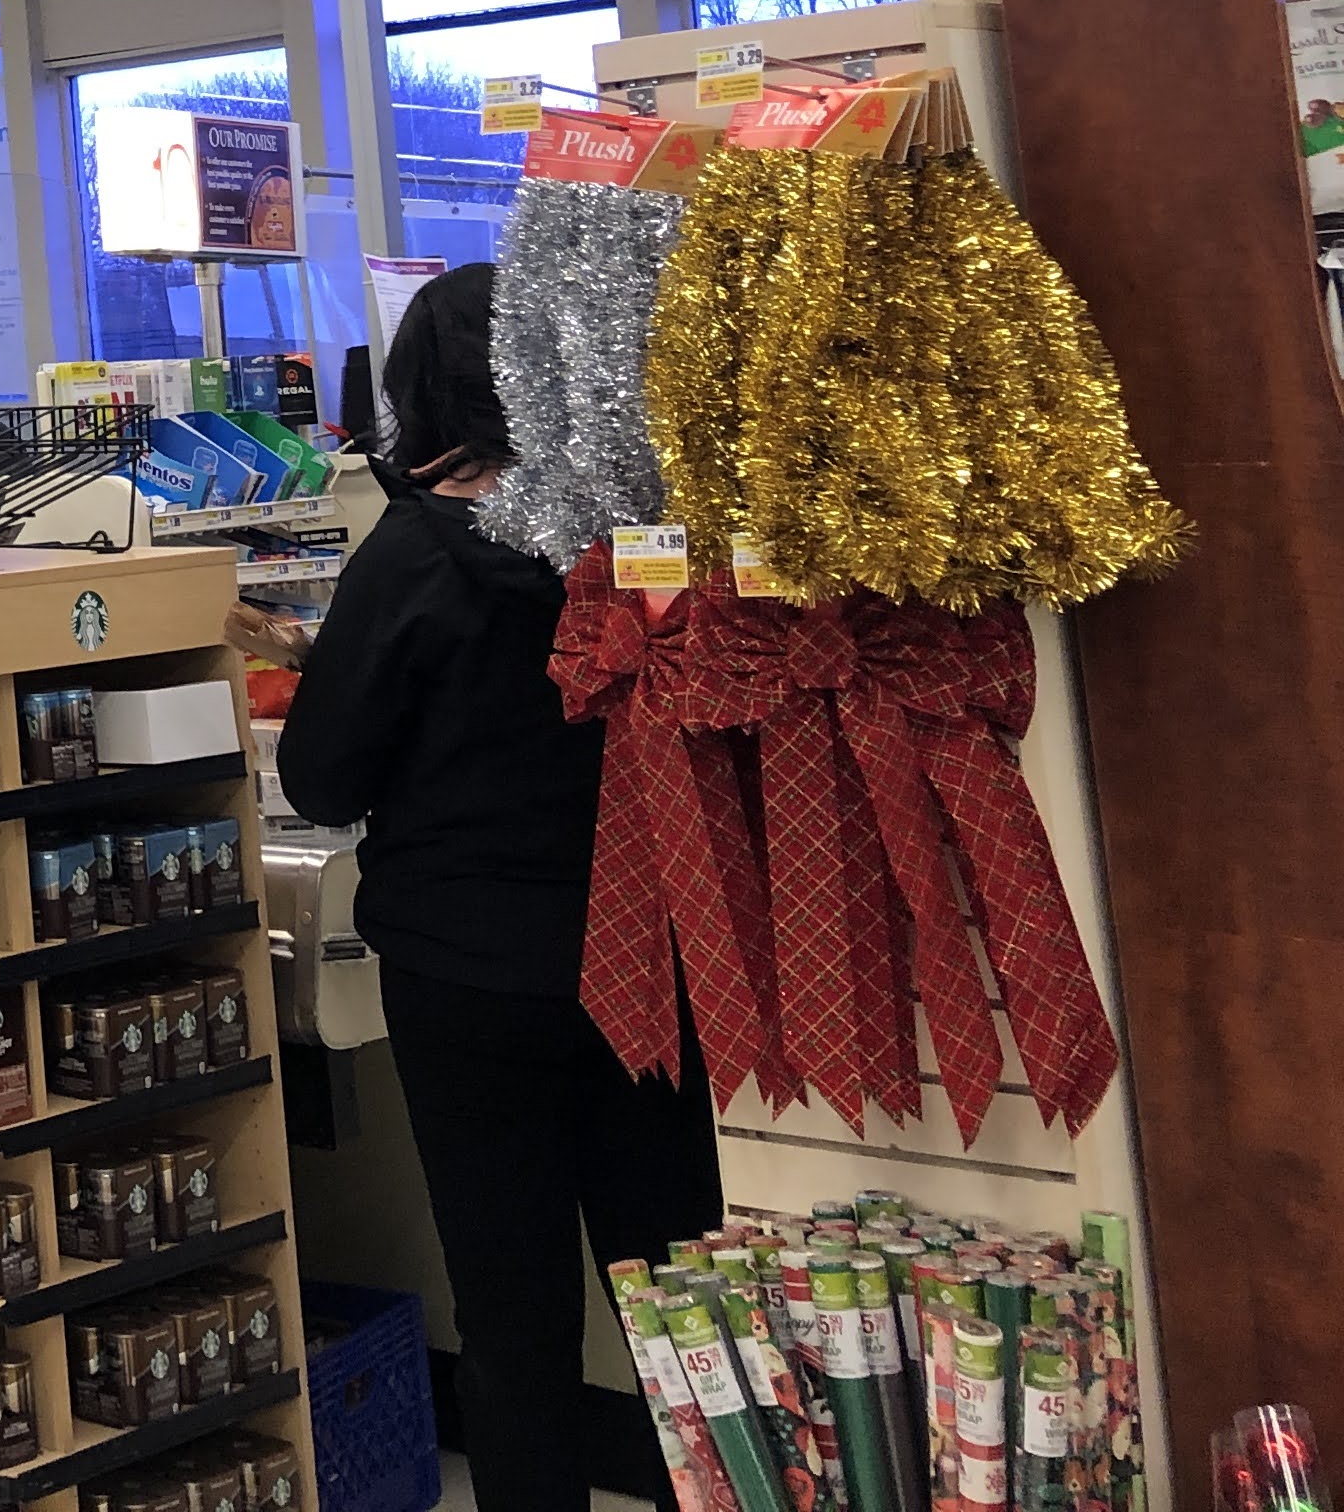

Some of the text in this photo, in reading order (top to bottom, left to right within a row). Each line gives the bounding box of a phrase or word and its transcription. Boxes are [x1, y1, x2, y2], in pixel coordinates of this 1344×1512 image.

[737, 49, 763, 66] 3.29
[756, 102, 829, 128] Plush
[209, 127, 278, 152] OUR PROMISE
[560, 130, 636, 162] Plush
[110, 375, 133, 387] ETFLIX
[278, 385, 312, 395] REGAL
[657, 534, 685, 549] 4.99
[687, 1351, 712, 1374] 45
[699, 1372, 719, 1385] GIFT
[701, 1381, 727, 1395] WRAP
[1038, 1395, 1065, 1417] 45
